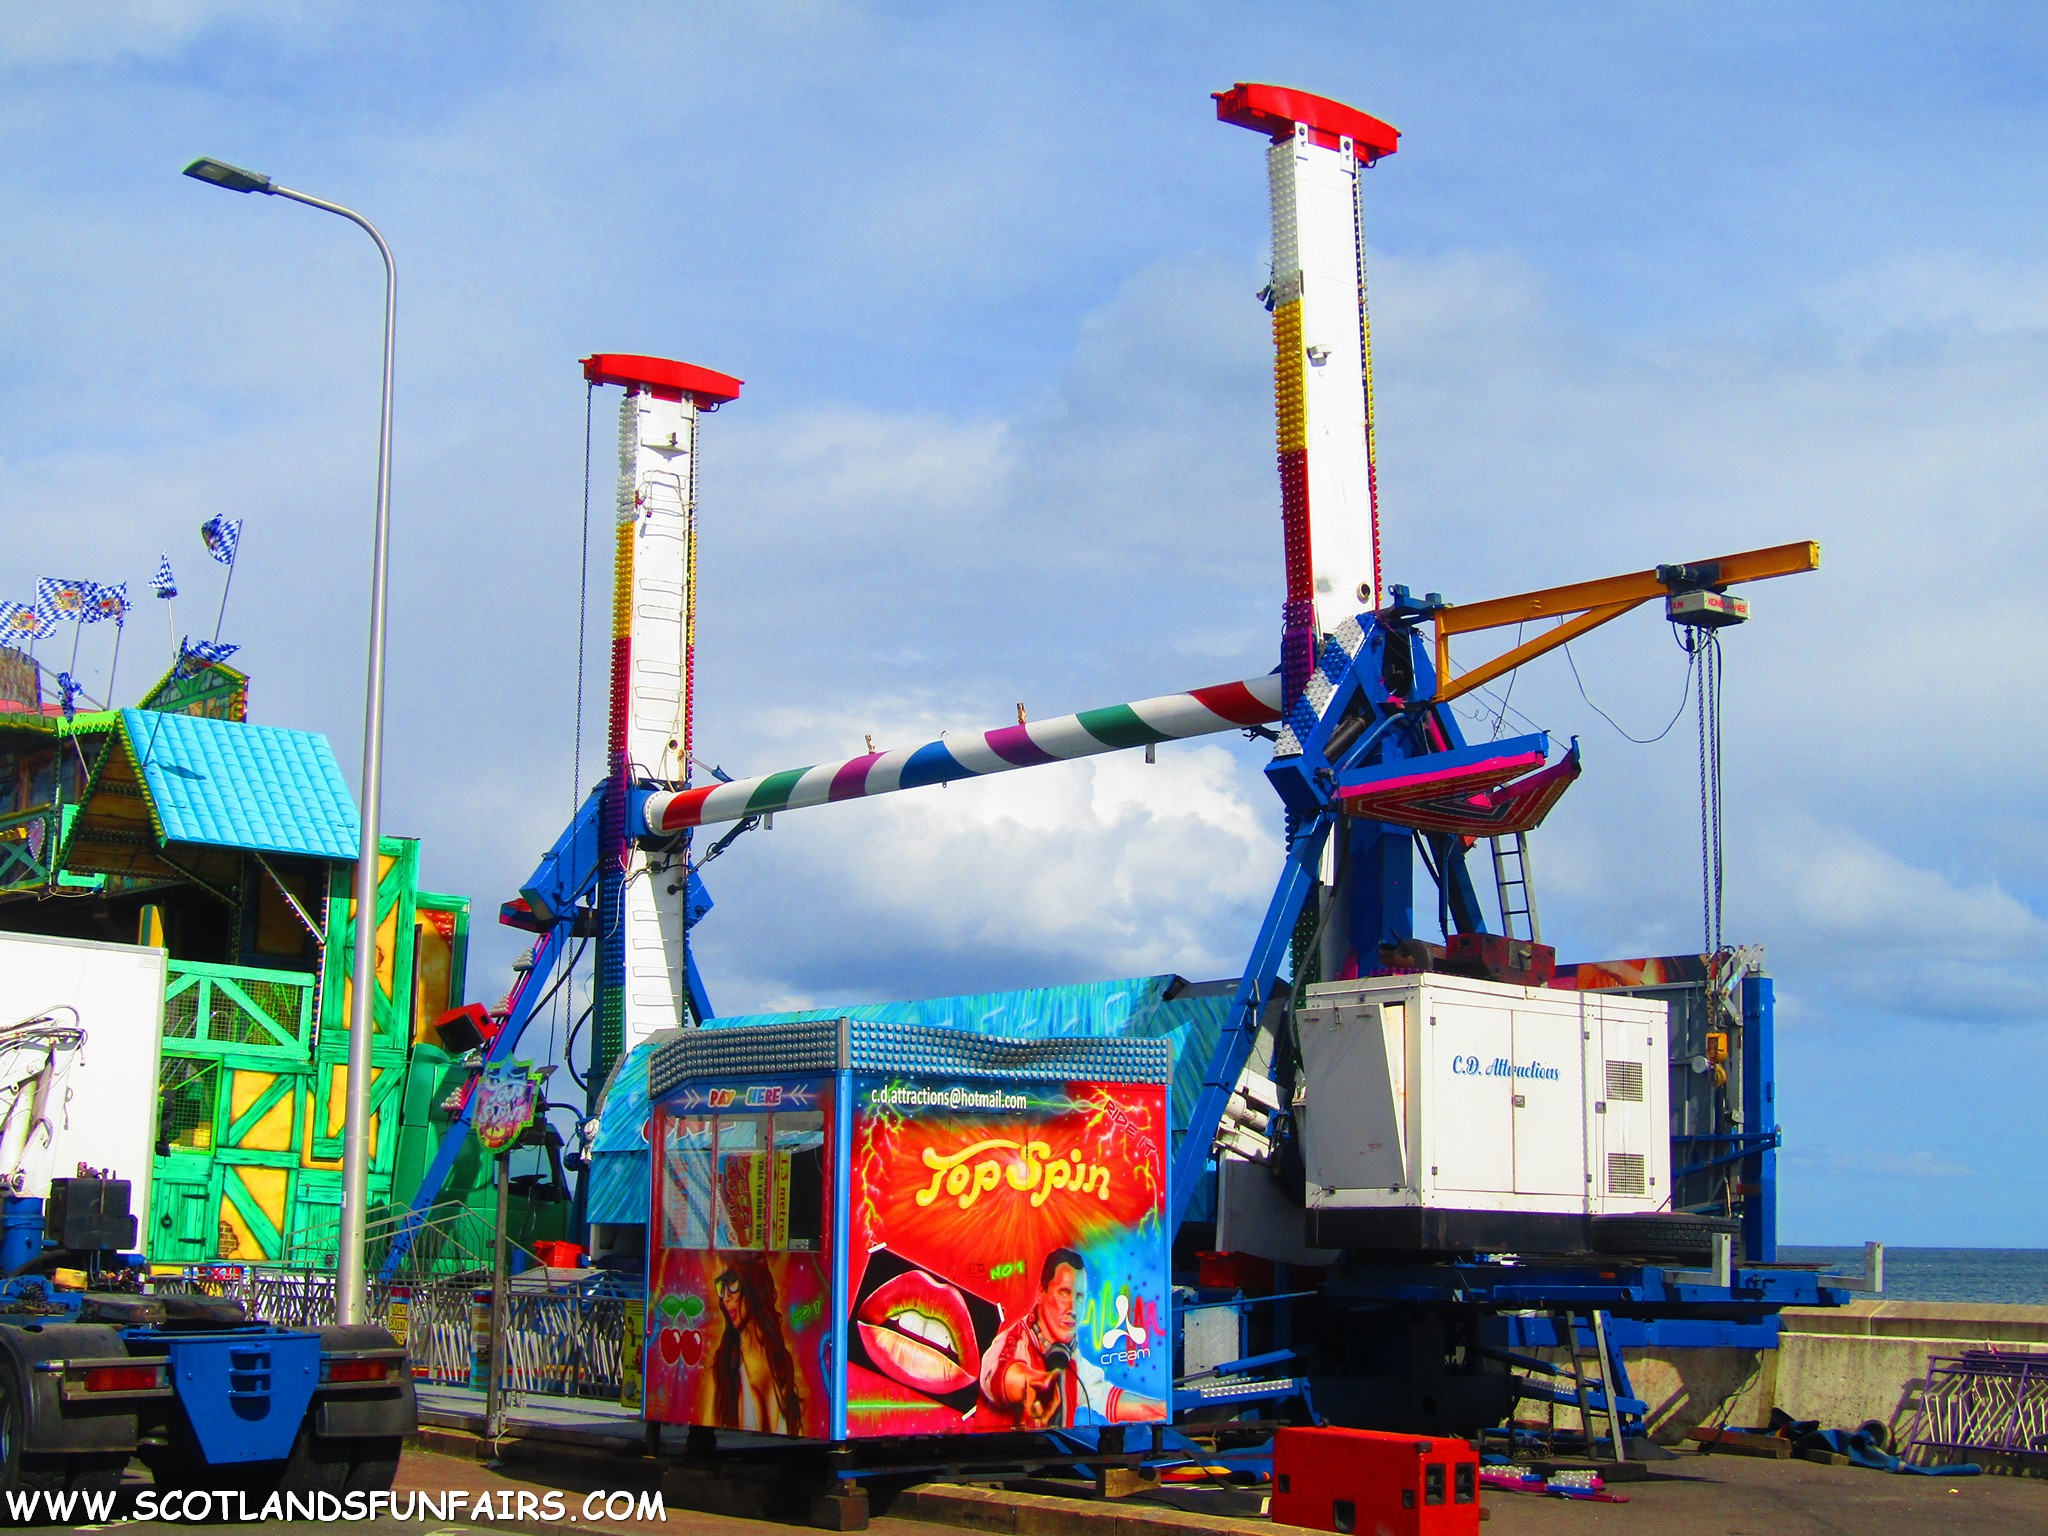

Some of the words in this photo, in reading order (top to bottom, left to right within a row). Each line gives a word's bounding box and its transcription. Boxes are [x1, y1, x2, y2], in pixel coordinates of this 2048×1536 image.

[1452, 1055, 1482, 1076] C.D.
[1485, 1057, 1560, 1081] Attractions
[708, 1088, 736, 1108] PAY
[745, 1086, 782, 1106] HERE
[871, 1084, 1027, 1109] c.d.attractions@hotmail.com
[1103, 1099, 1138, 1137] RIDE
[780, 1159, 789, 1181] 1.3
[915, 1138, 1021, 1210] Top
[1005, 1140, 1111, 1208] Spin
[778, 1187, 787, 1242] metres
[990, 1264, 1013, 1280] NO
[1015, 1261, 1025, 1275] 1
[1100, 1347, 1151, 1365] cream
